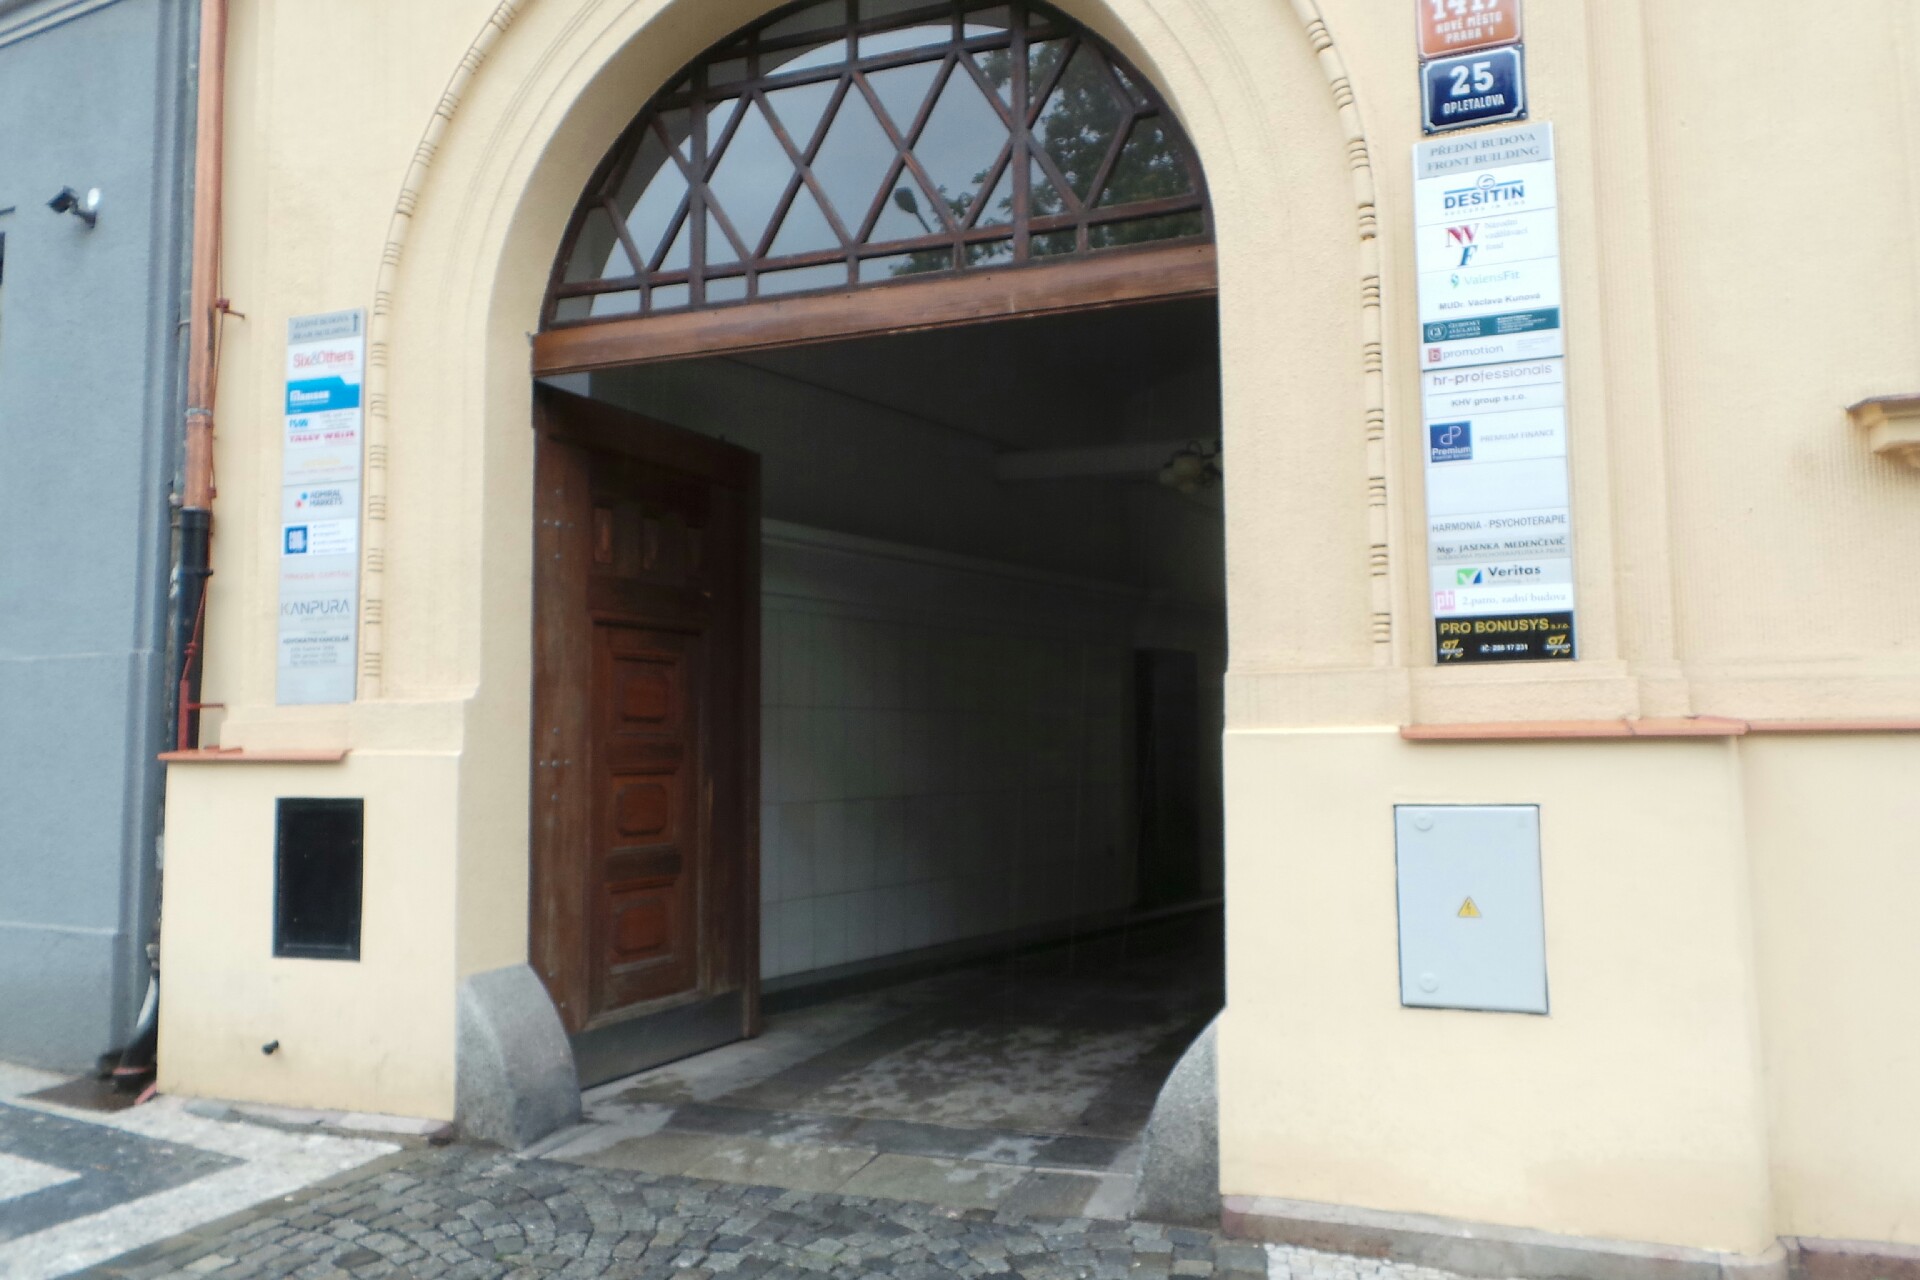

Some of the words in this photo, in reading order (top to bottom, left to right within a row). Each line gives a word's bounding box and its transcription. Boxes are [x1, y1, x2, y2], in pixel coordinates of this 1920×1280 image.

[1436, 17, 1463, 34] NOVÉ
[1445, 27, 1482, 43] PRAHA
[1488, 25, 1494, 36] 1
[1449, 61, 1494, 96] 25
[1443, 94, 1505, 115] OPLETALOVA
[1430, 140, 1478, 157] PŘEDNÍ
[1481, 132, 1536, 149] BUDOVA
[1427, 155, 1471, 171] FRONT
[1474, 146, 1540, 164] BUILDING
[1444, 185, 1525, 209] DESITIN
[1464, 270, 1521, 286] ValensFit
[1438, 301, 1465, 311] MUDr.
[1468, 297, 1503, 307] Václava
[1505, 292, 1541, 303] Kunová
[1443, 344, 1504, 360] promotion
[1433, 364, 1552, 386] hr-professionals
[1451, 398, 1471, 408] KHV
[1474, 395, 1501, 407] group
[1504, 393, 1527, 402] s.r.o.
[1480, 432, 1519, 443] PREMIUM
[1521, 429, 1554, 439] FINANCE
[1432, 446, 1471, 456] Premium
[309, 496, 343, 507] MARKETS
[310, 489, 340, 499] ADMIRAL
[1432, 520, 1482, 533] HARMONIA
[1489, 514, 1567, 529] PSYCHOTERAPIE
[1487, 565, 1542, 577] Veritas
[1501, 593, 1527, 604] zadní
[1529, 591, 1567, 602] budova
[280, 598, 350, 616] KANPURA
[1440, 621, 1472, 635] PRO
[1474, 618, 1549, 634] BONUSYS
